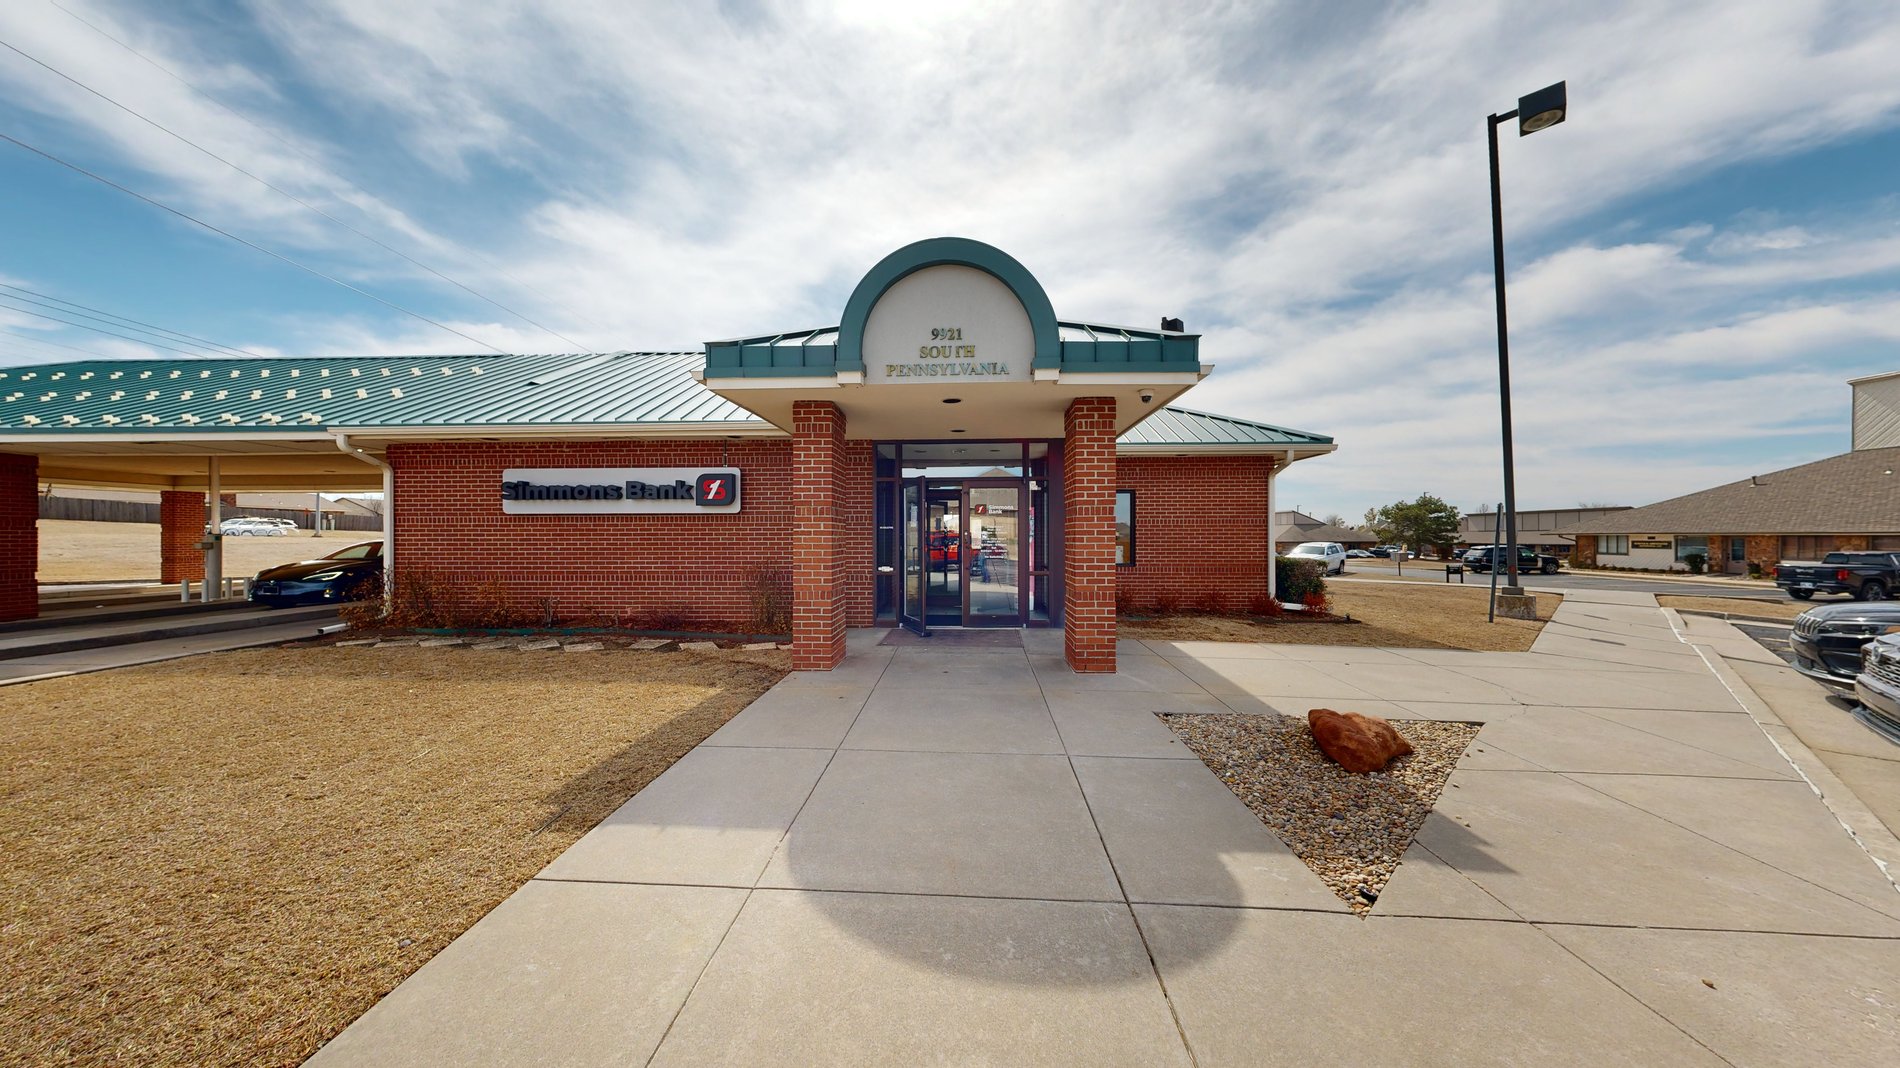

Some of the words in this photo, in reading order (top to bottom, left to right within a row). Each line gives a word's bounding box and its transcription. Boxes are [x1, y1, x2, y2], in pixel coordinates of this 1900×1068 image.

[931, 328, 963, 341] 9921
[919, 345, 976, 359] SOUTH
[886, 362, 1010, 377] PENNSYLVANIA
[502, 480, 623, 500] Simmons
[625, 480, 695, 500] Bank
